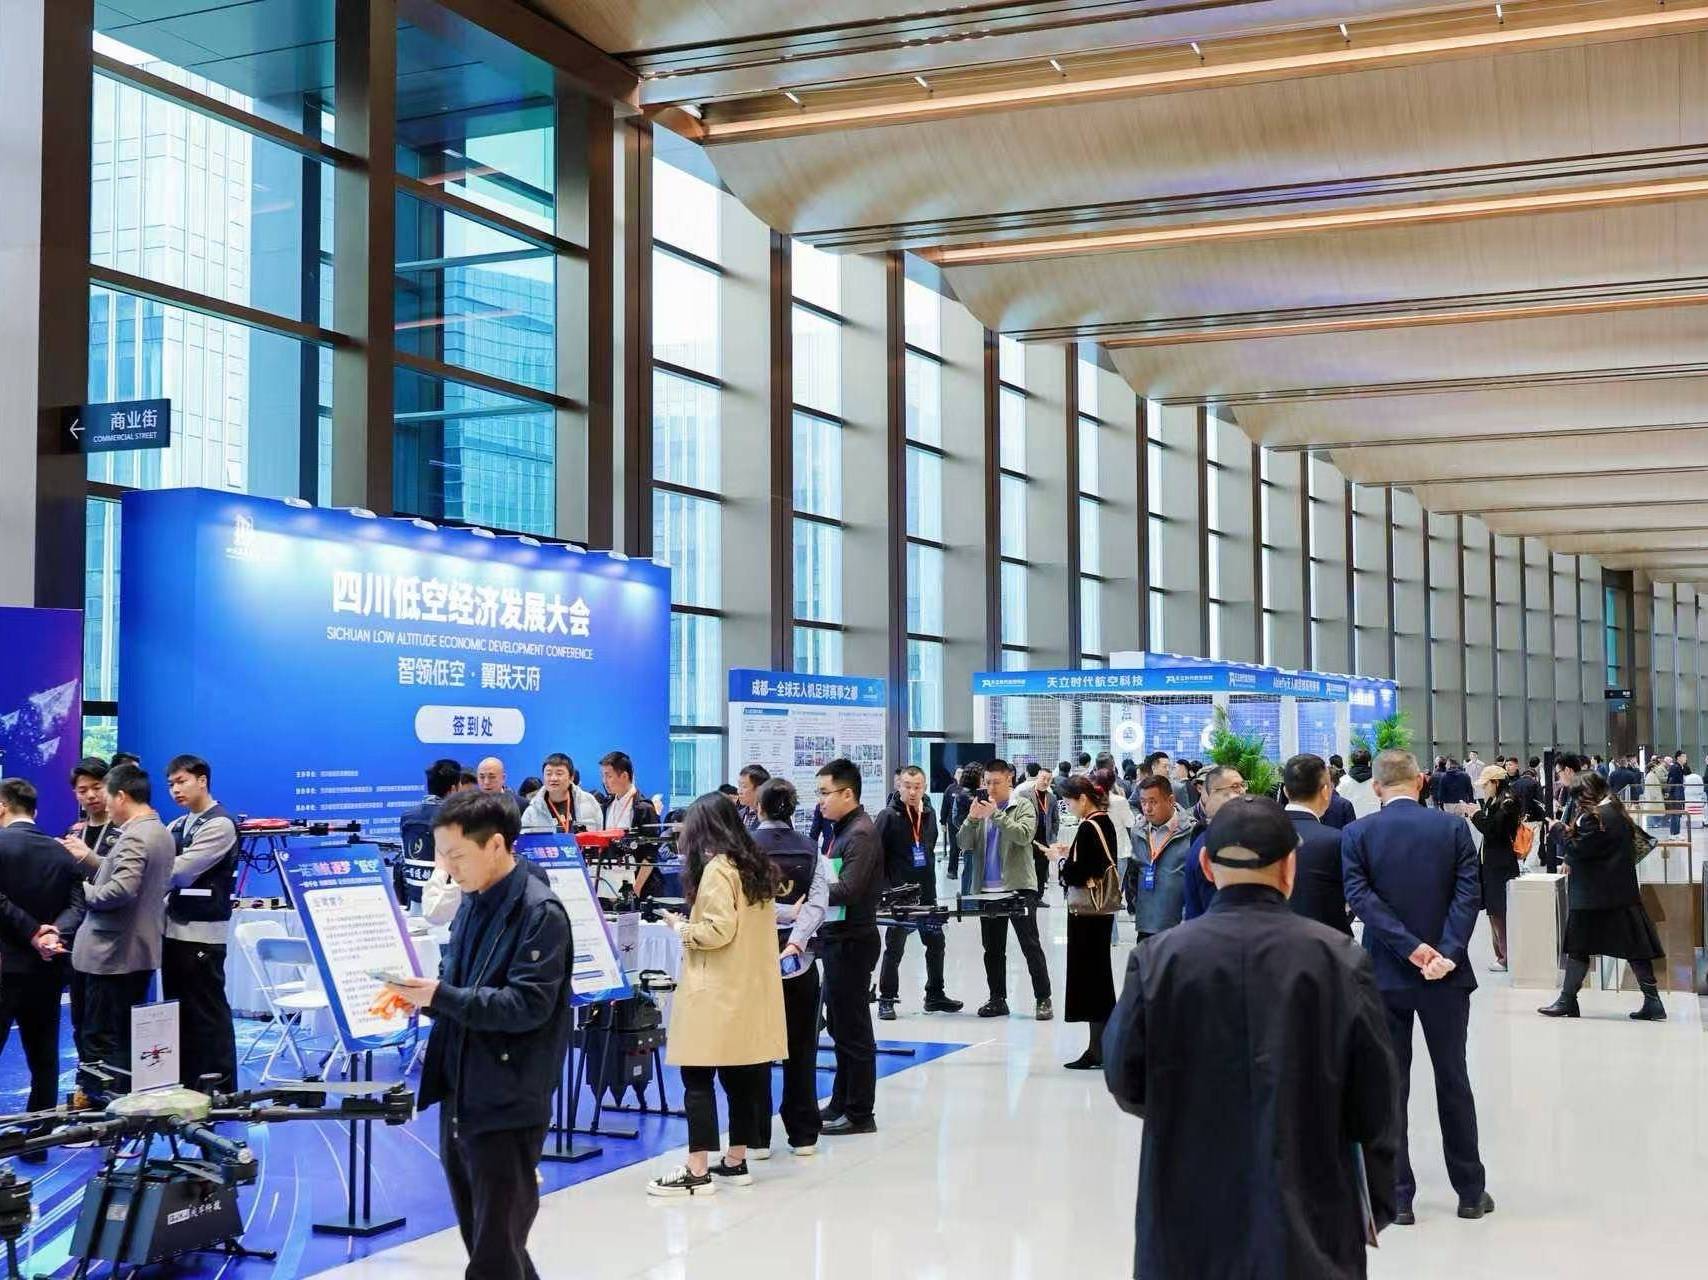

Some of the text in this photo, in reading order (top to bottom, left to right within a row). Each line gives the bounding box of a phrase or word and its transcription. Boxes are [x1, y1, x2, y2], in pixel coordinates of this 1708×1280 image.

[110, 409, 158, 431] 商业街
[93, 431, 158, 443] COMMERCIAL STREET
[332, 571, 592, 638] 四川低空经济发展大会
[326, 626, 594, 660] SICHUAN LOW ALTITUDE ECONOMIC DEVELOPMENT CONFERENCE
[1047, 675, 1144, 689] 天立时代航空科技
[452, 715, 494, 738] 签到处
